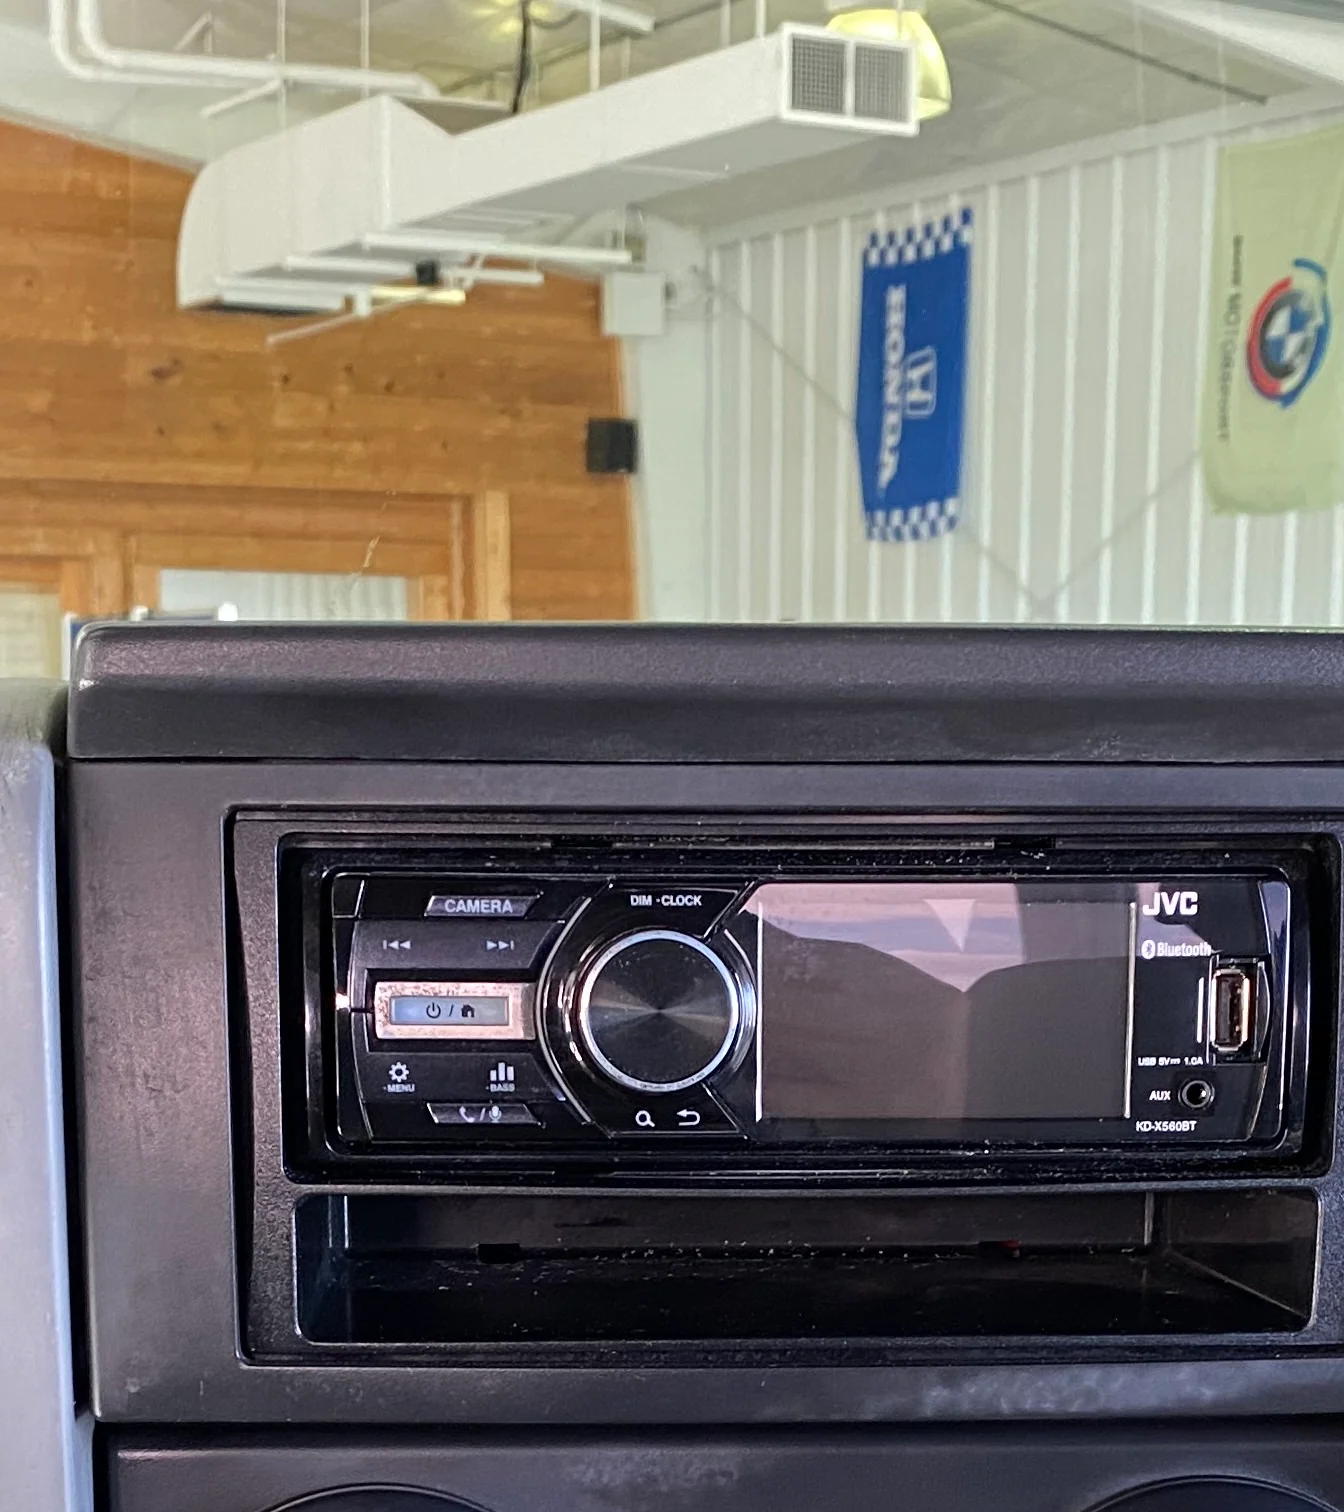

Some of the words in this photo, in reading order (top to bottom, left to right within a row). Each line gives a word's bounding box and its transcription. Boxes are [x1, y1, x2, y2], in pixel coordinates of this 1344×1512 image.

[878, 284, 906, 492] HONDA
[444, 899, 513, 913] CAMERA
[630, 894, 653, 906] DIM
[1142, 891, 1198, 916] JVC
[1157, 941, 1212, 957] Bluetooth
[1138, 1056, 1156, 1066] USB
[1184, 1056, 1203, 1066] 1.0A
[387, 1083, 415, 1092] MENU
[490, 1083, 515, 1092] BASS
[1149, 1090, 1171, 1101] AUX
[1136, 1120, 1197, 1132] KD-X560BT
